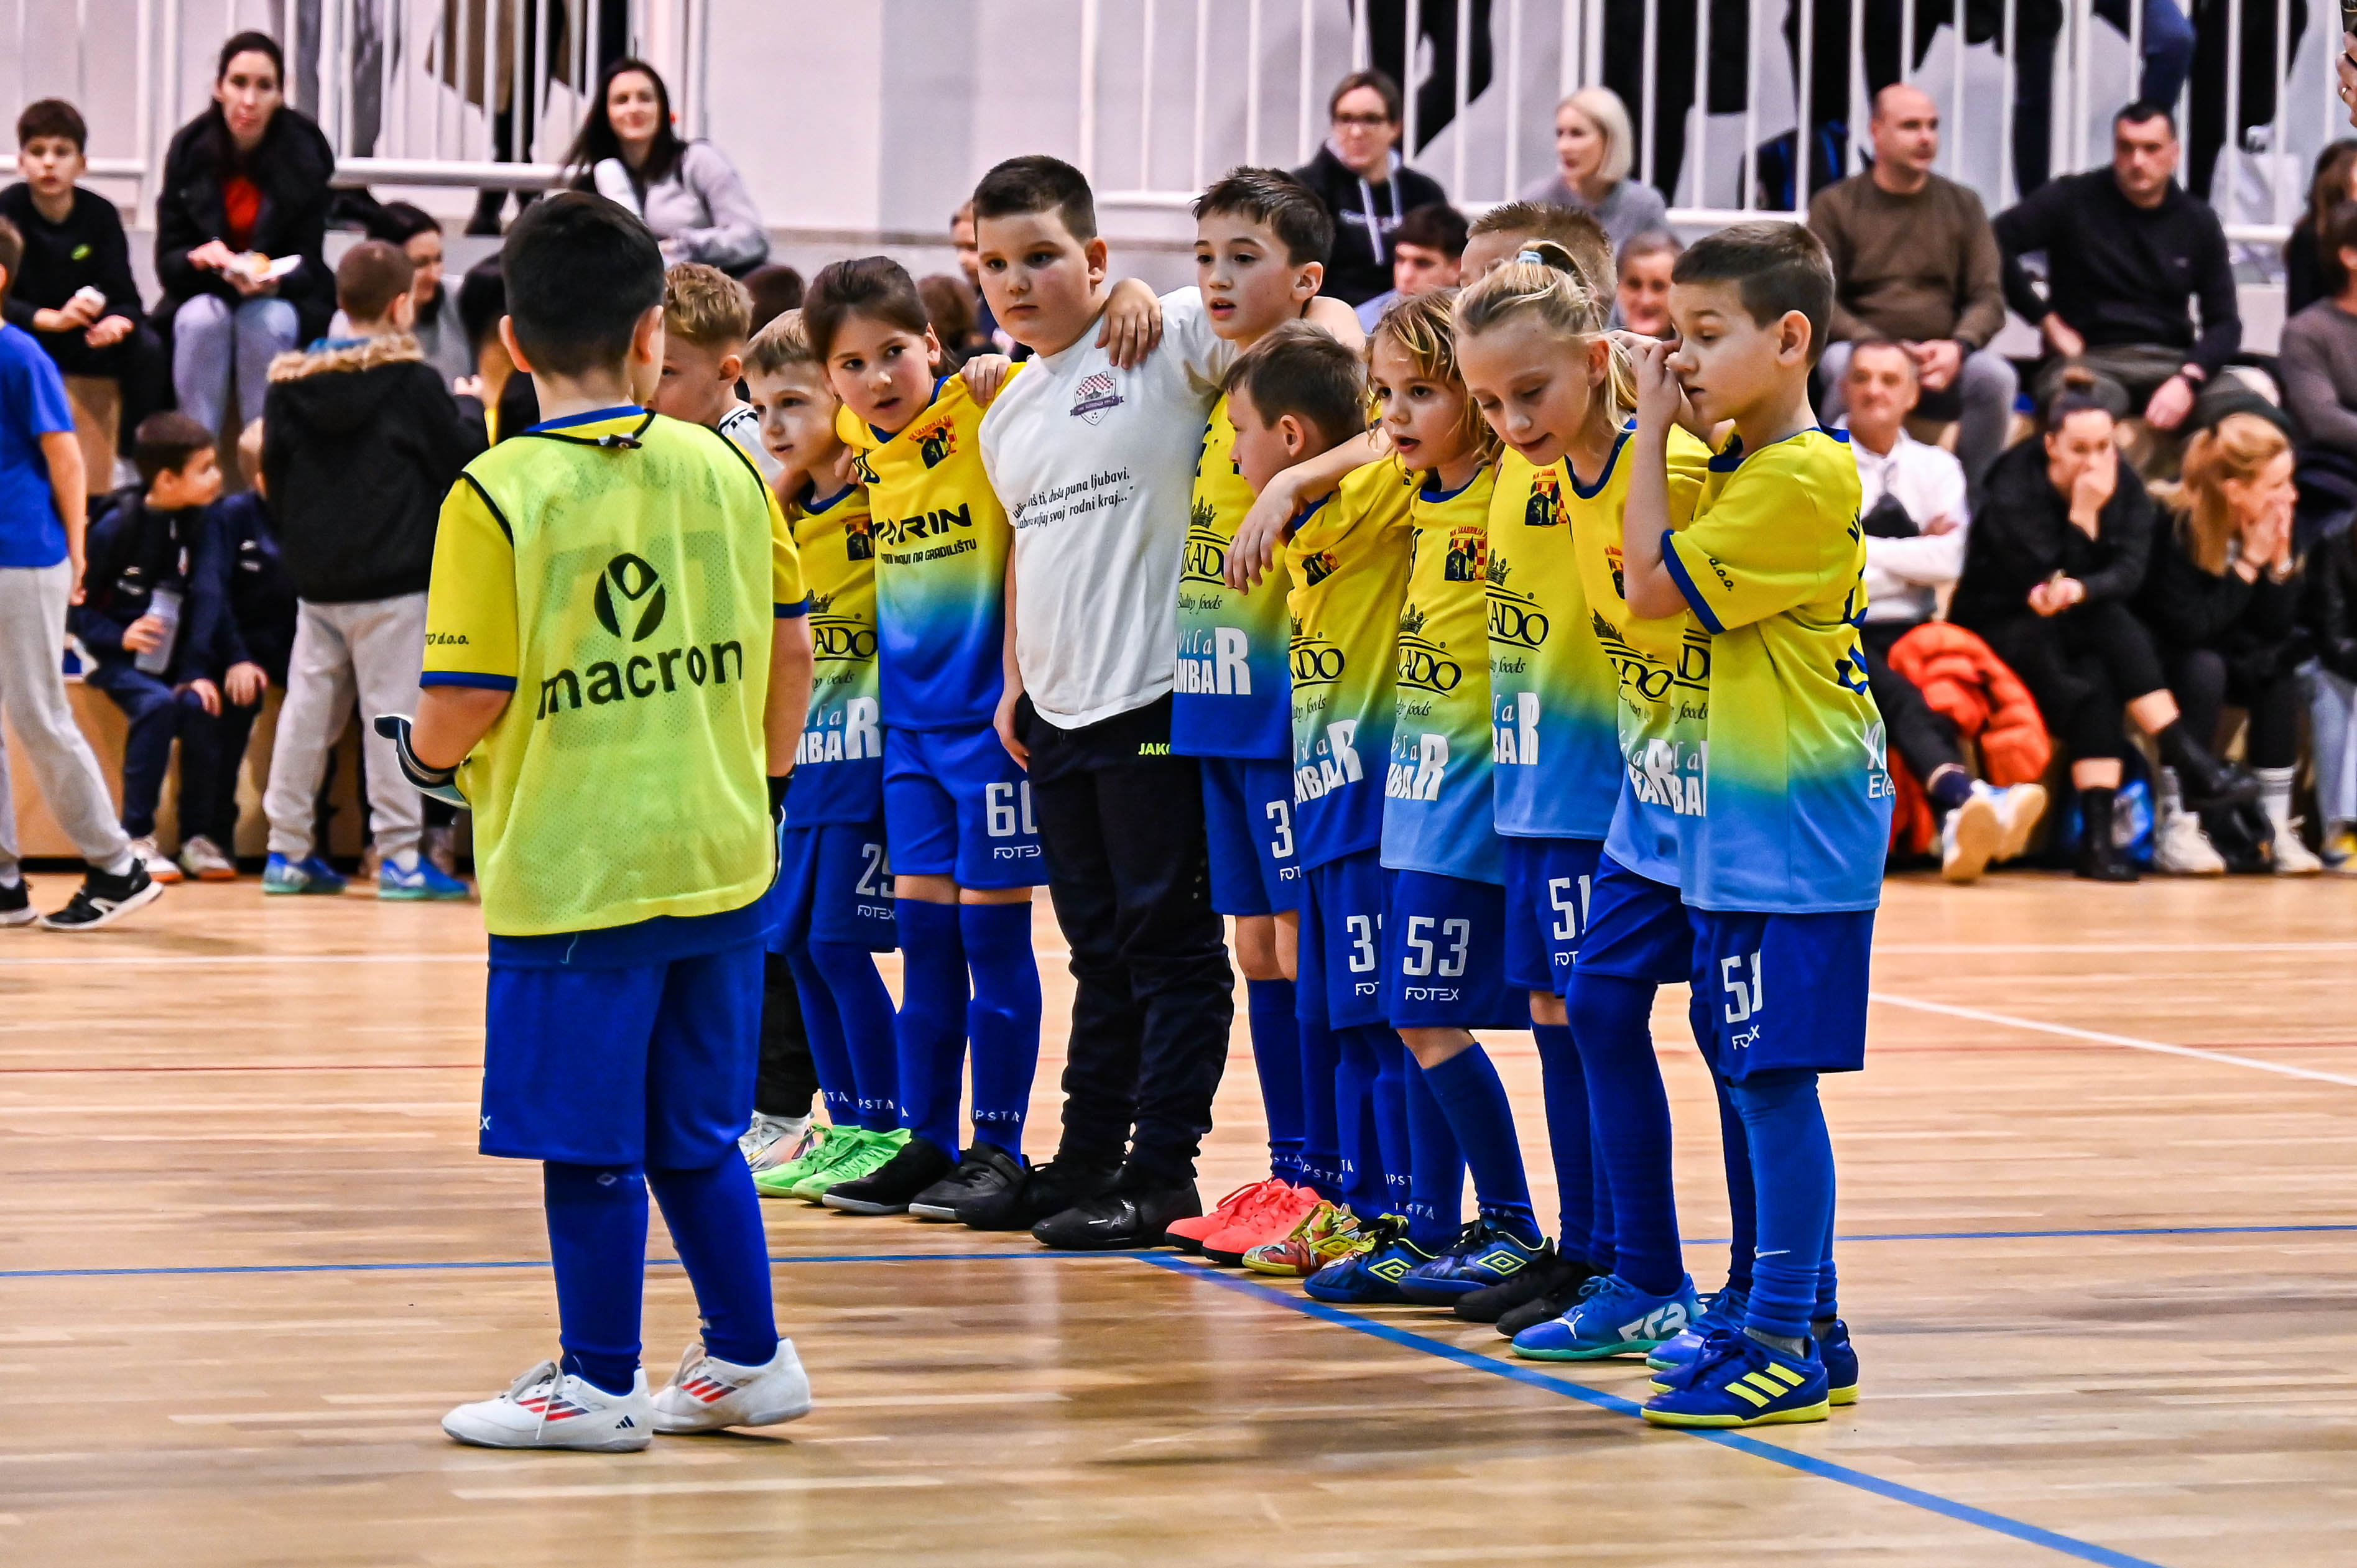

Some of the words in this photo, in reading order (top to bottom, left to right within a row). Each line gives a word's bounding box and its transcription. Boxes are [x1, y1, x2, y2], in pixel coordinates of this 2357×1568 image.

[1065, 481, 1088, 500] puna
[1091, 466, 1130, 491] ljubavi.
[1050, 505, 1065, 522] svoj
[1070, 496, 1095, 517] rodni
[925, 538, 977, 561] GRADILIŠTU
[1486, 598, 1549, 646] ADO
[437, 632, 470, 645] d.o.o.
[813, 626, 878, 658] ADO
[537, 640, 742, 720] macron
[1279, 865, 1302, 882] FOT
[857, 904, 896, 920] FOTEX
[1346, 913, 1382, 972] 3
[1402, 915, 1470, 977] 53
[1554, 951, 1579, 967] FOT
[1405, 987, 1459, 1001] FOTEX
[1386, 1173, 1413, 1186] IPST
